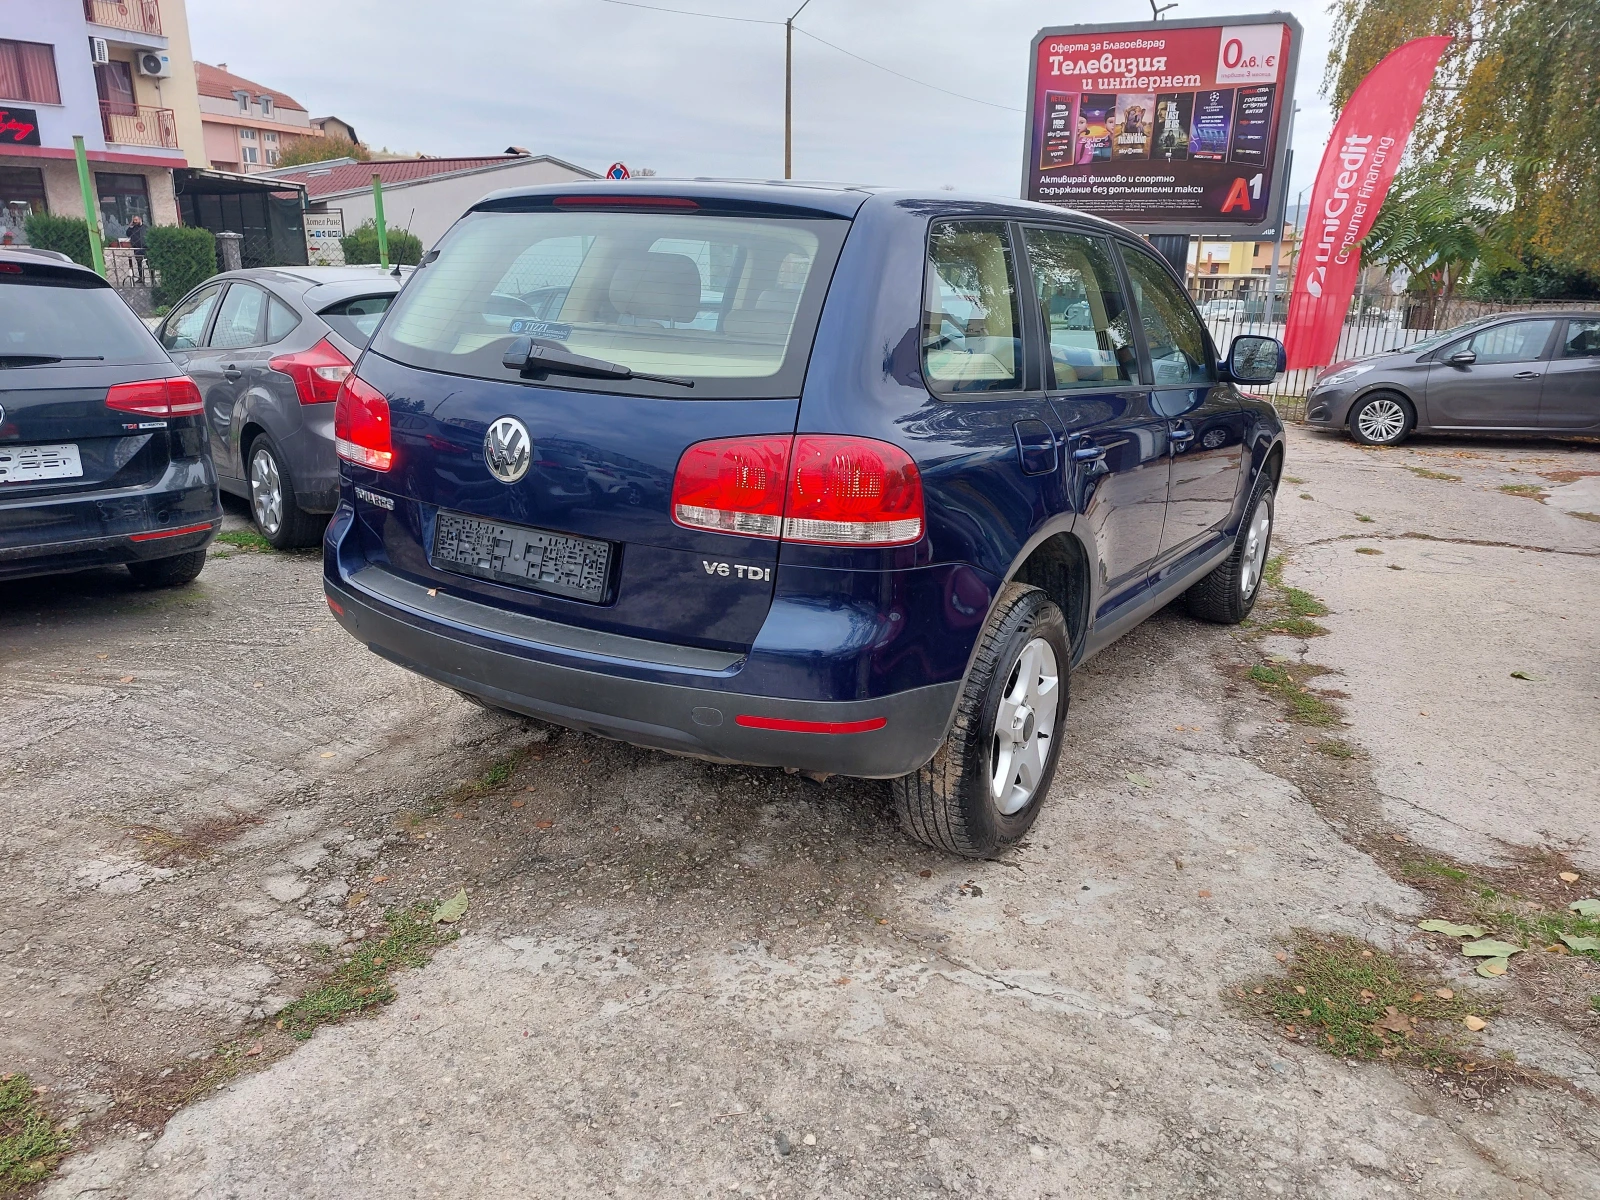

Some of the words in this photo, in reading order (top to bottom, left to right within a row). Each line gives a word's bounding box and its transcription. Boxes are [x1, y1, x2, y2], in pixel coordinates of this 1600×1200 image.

[1050, 43, 1089, 53] Оферта
[1090, 43, 1101, 53] за
[1103, 39, 1165, 50] Благоевград
[1049, 53, 1167, 77] Телевизия
[1082, 79, 1093, 90] и
[1098, 74, 1201, 92] интернет
[1167, 102, 1177, 111] THE
[1165, 111, 1180, 120] LAST
[1164, 120, 1172, 129] OF
[1172, 120, 1180, 129] US
[1040, 174, 1088, 185] Активирай
[1088, 174, 1127, 185] филмово
[1135, 175, 1175, 185] спортно
[1039, 186, 1092, 195] съдържание
[1092, 185, 1107, 195] без
[1109, 185, 1173, 195] допълнителни
[1174, 185, 1204, 194] такси
[1221, 173, 1263, 213] A1
[1315, 134, 1372, 262] UniCredit
[1334, 200, 1367, 265] Consumer
[1357, 136, 1395, 198] Financing
[306, 218, 325, 226] Хотел
[326, 218, 341, 226] Ринг
[524, 322, 549, 333] TIZZI
[702, 560, 730, 577] V6
[734, 564, 771, 582] TDI
